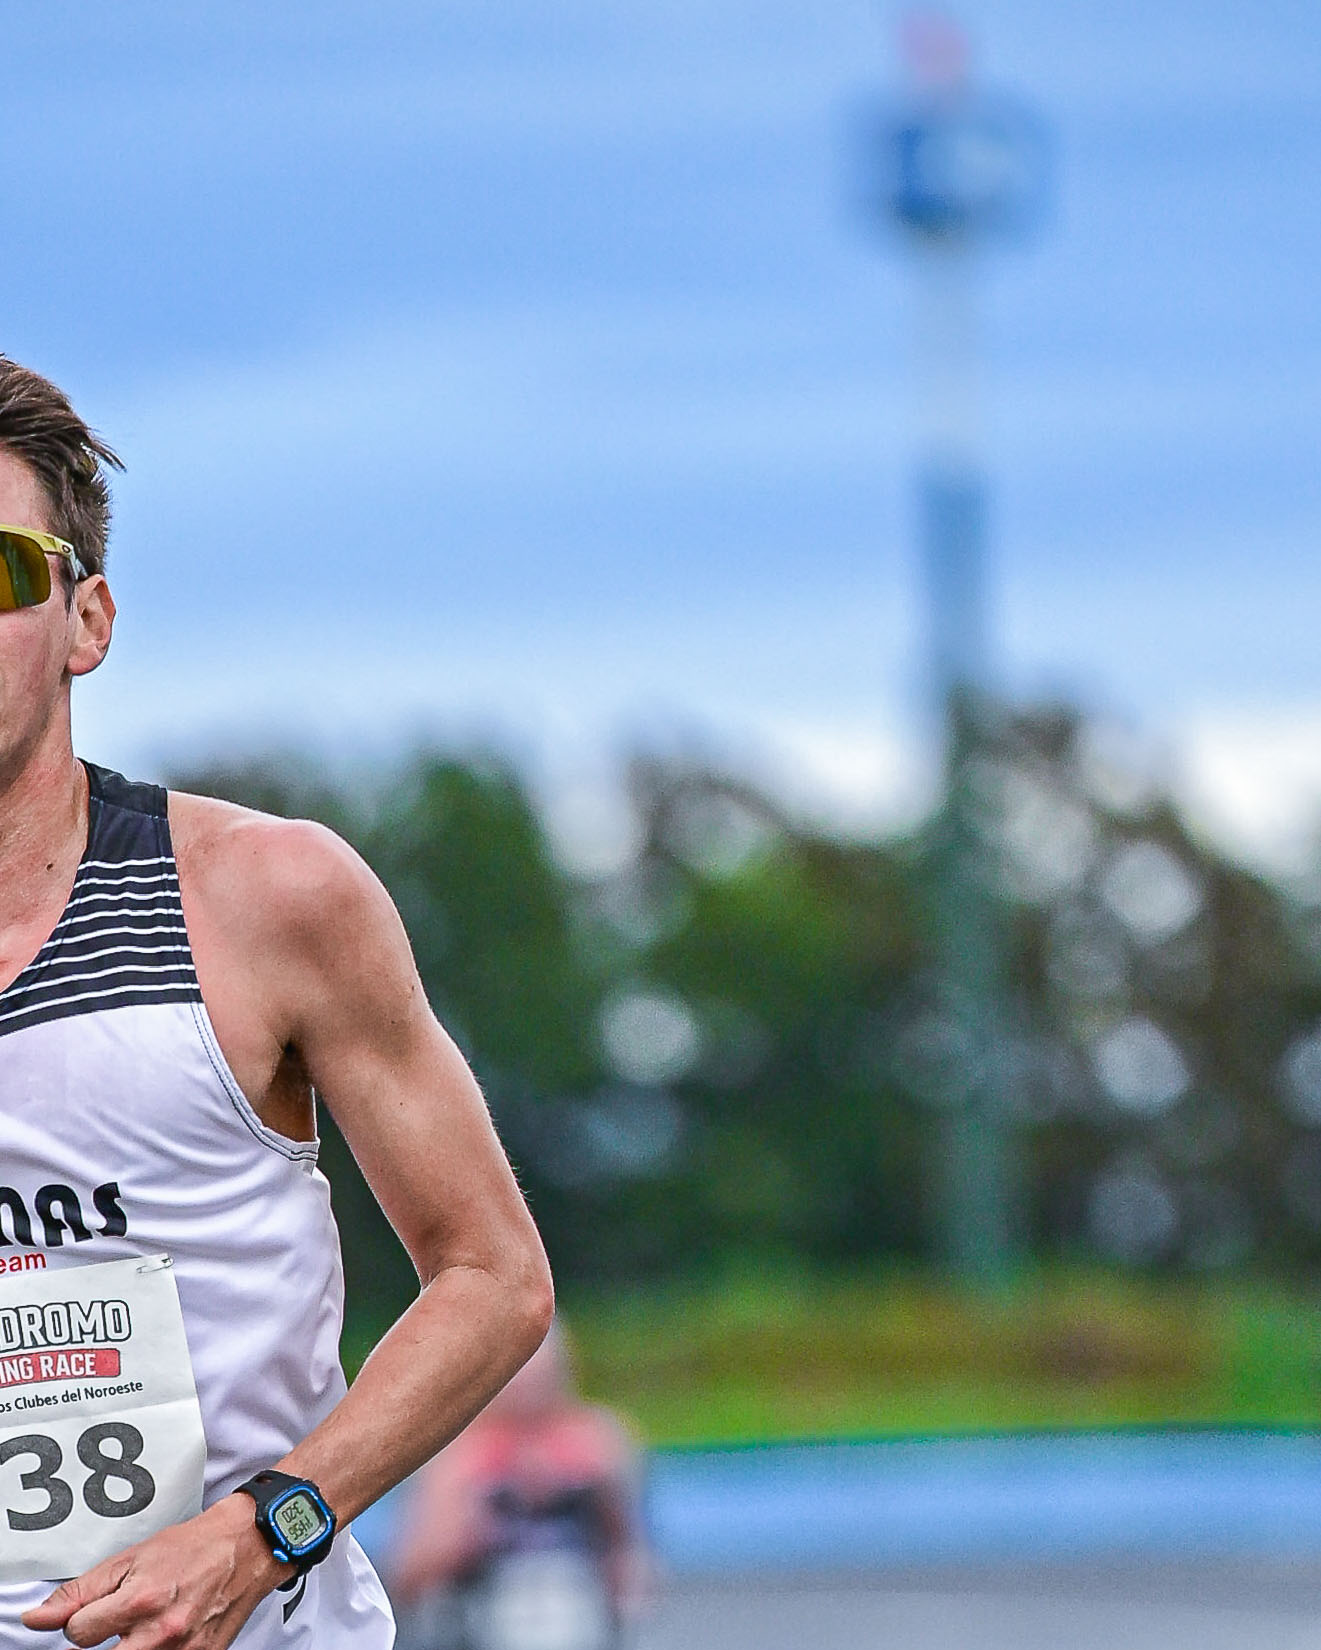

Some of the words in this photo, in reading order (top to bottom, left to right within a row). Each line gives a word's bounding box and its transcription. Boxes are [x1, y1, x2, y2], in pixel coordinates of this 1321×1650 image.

[40, 1353, 97, 1379] RACE
[14, 1392, 59, 1410] Clubes
[61, 1387, 82, 1403] del
[84, 1380, 144, 1399] Noroeste
